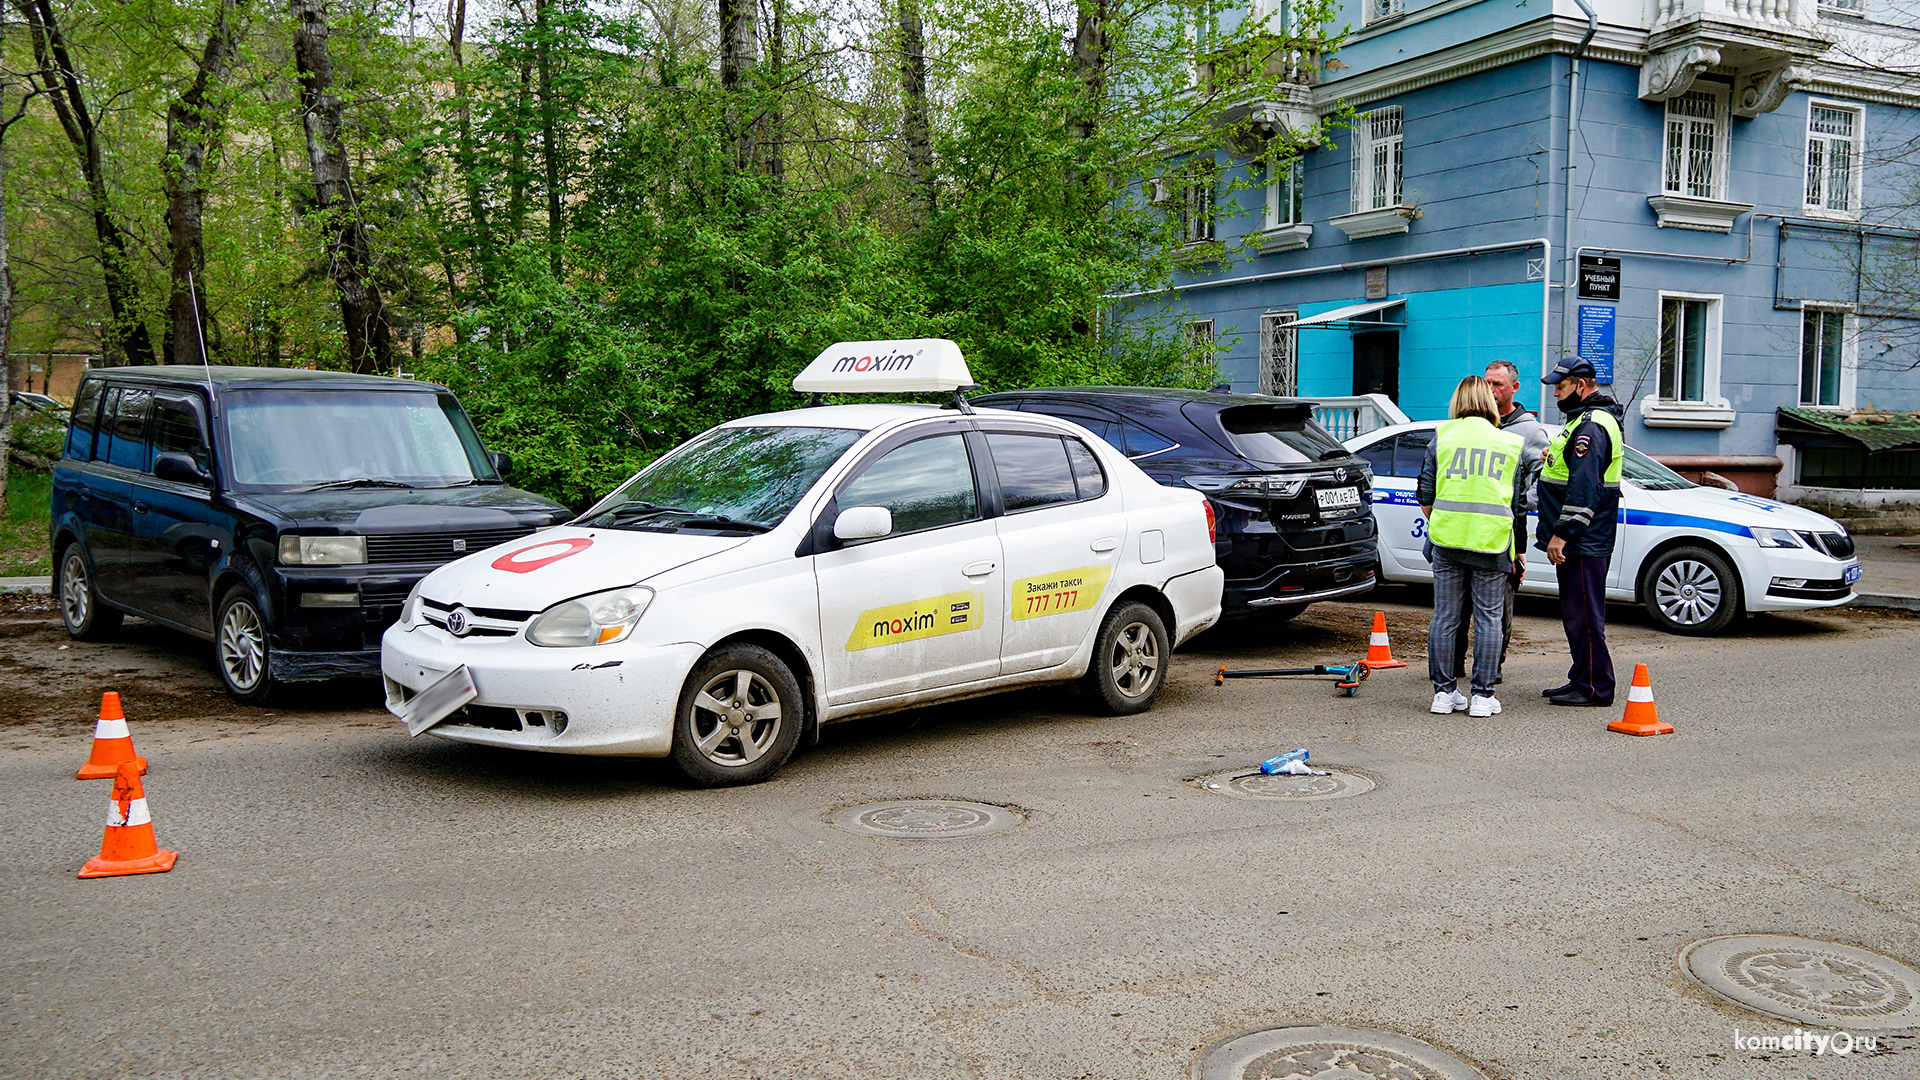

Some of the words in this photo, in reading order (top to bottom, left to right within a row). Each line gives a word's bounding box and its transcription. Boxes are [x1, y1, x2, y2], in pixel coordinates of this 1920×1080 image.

[1584, 273, 1616, 283] УЧЕБНЫЙ
[1589, 283, 1610, 292] ПУНКТ
[1446, 447, 1507, 481] ДПС
[1410, 517, 1428, 539] 3
[1026, 582, 1059, 593] Закажи
[1060, 578, 1083, 588] такси
[1026, 594, 1050, 614] 777
[1055, 590, 1078, 610] 777
[873, 610, 935, 638] maxim
